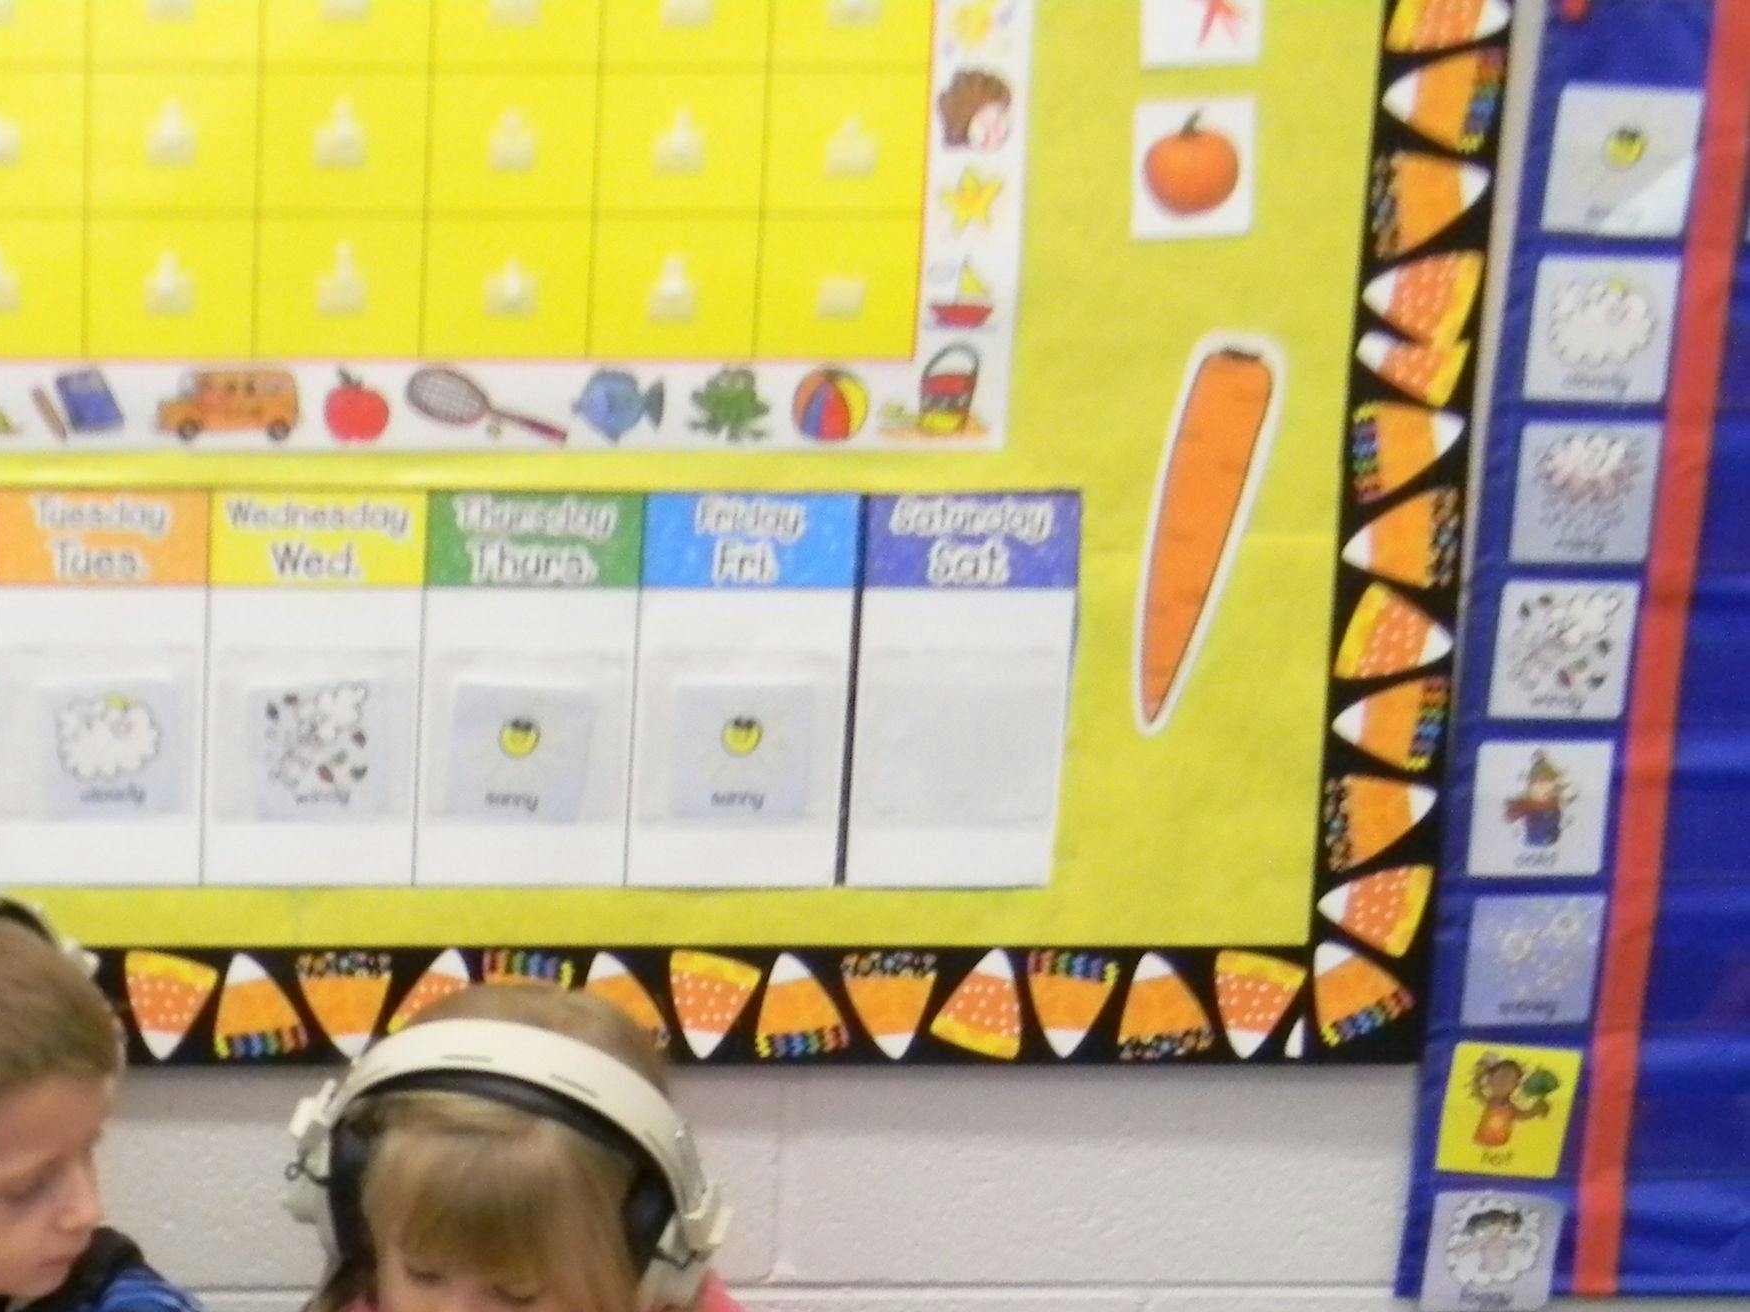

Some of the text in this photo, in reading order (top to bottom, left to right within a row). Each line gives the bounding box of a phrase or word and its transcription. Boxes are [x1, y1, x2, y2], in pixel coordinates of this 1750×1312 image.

[37, 497, 166, 535] Tuesday
[227, 498, 411, 537] Wednesday
[456, 496, 614, 540] Thursday
[699, 496, 803, 541] Friday
[893, 498, 1051, 541] Saturday
